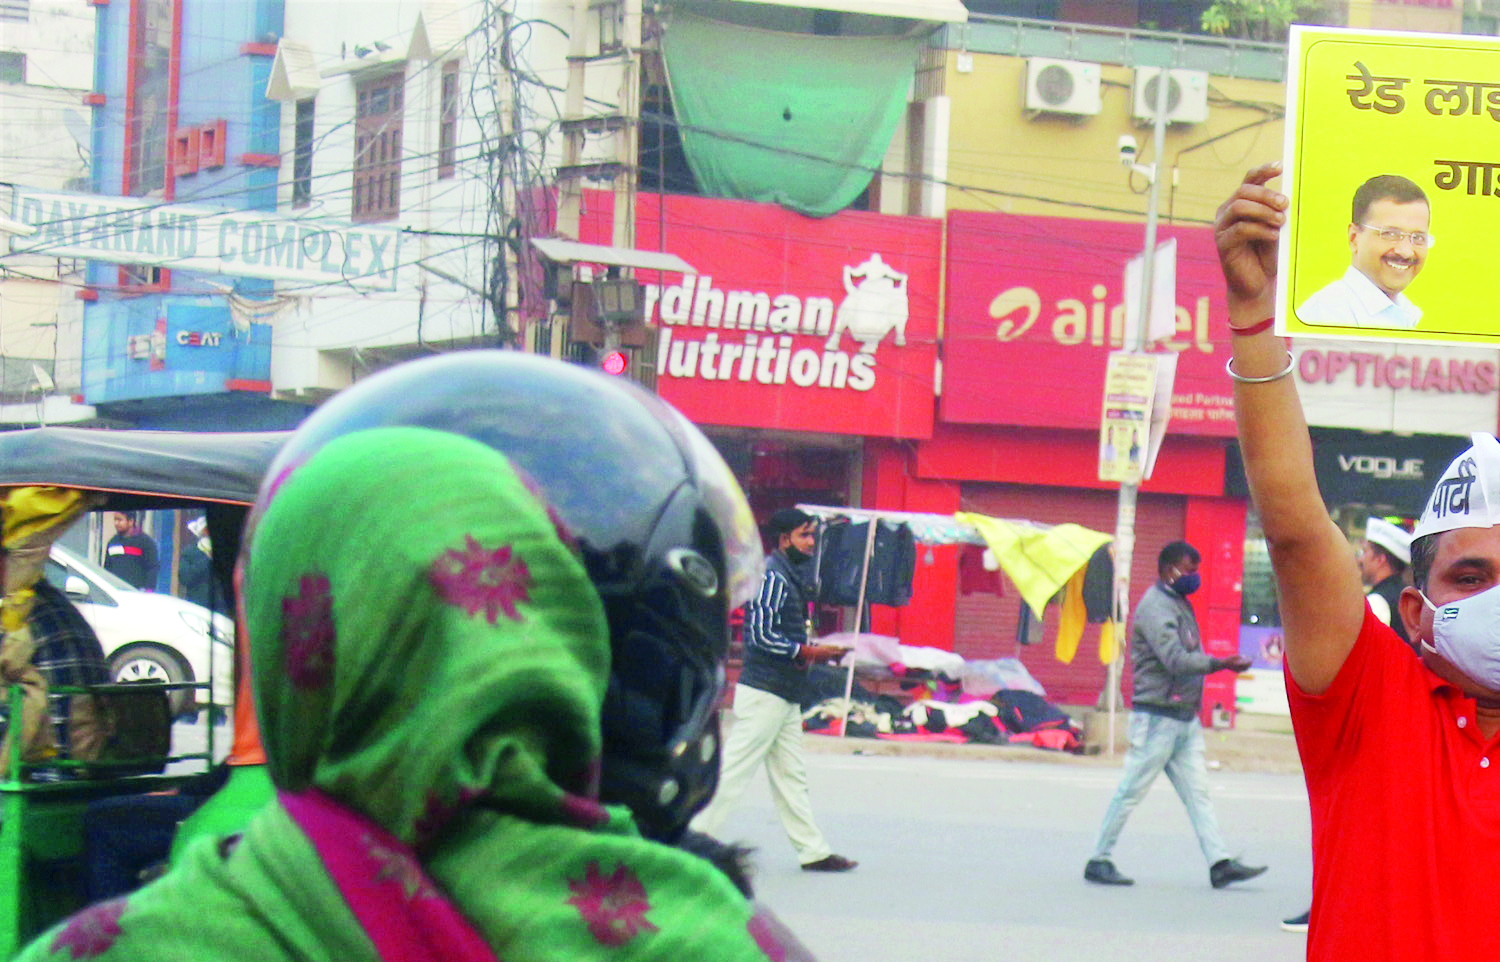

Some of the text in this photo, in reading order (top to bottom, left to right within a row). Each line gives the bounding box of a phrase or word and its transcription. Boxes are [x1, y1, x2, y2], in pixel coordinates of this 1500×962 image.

[1346, 61, 1411, 115] रेड
[21, 196, 391, 280] DAYANAND COMPLEX
[645, 273, 835, 336] rdhman
[1052, 284, 1214, 353] airel
[176, 330, 222, 347] CEAT
[1300, 349, 1497, 397] OPTICIANS
[1338, 454, 1425, 479] VOGUE
